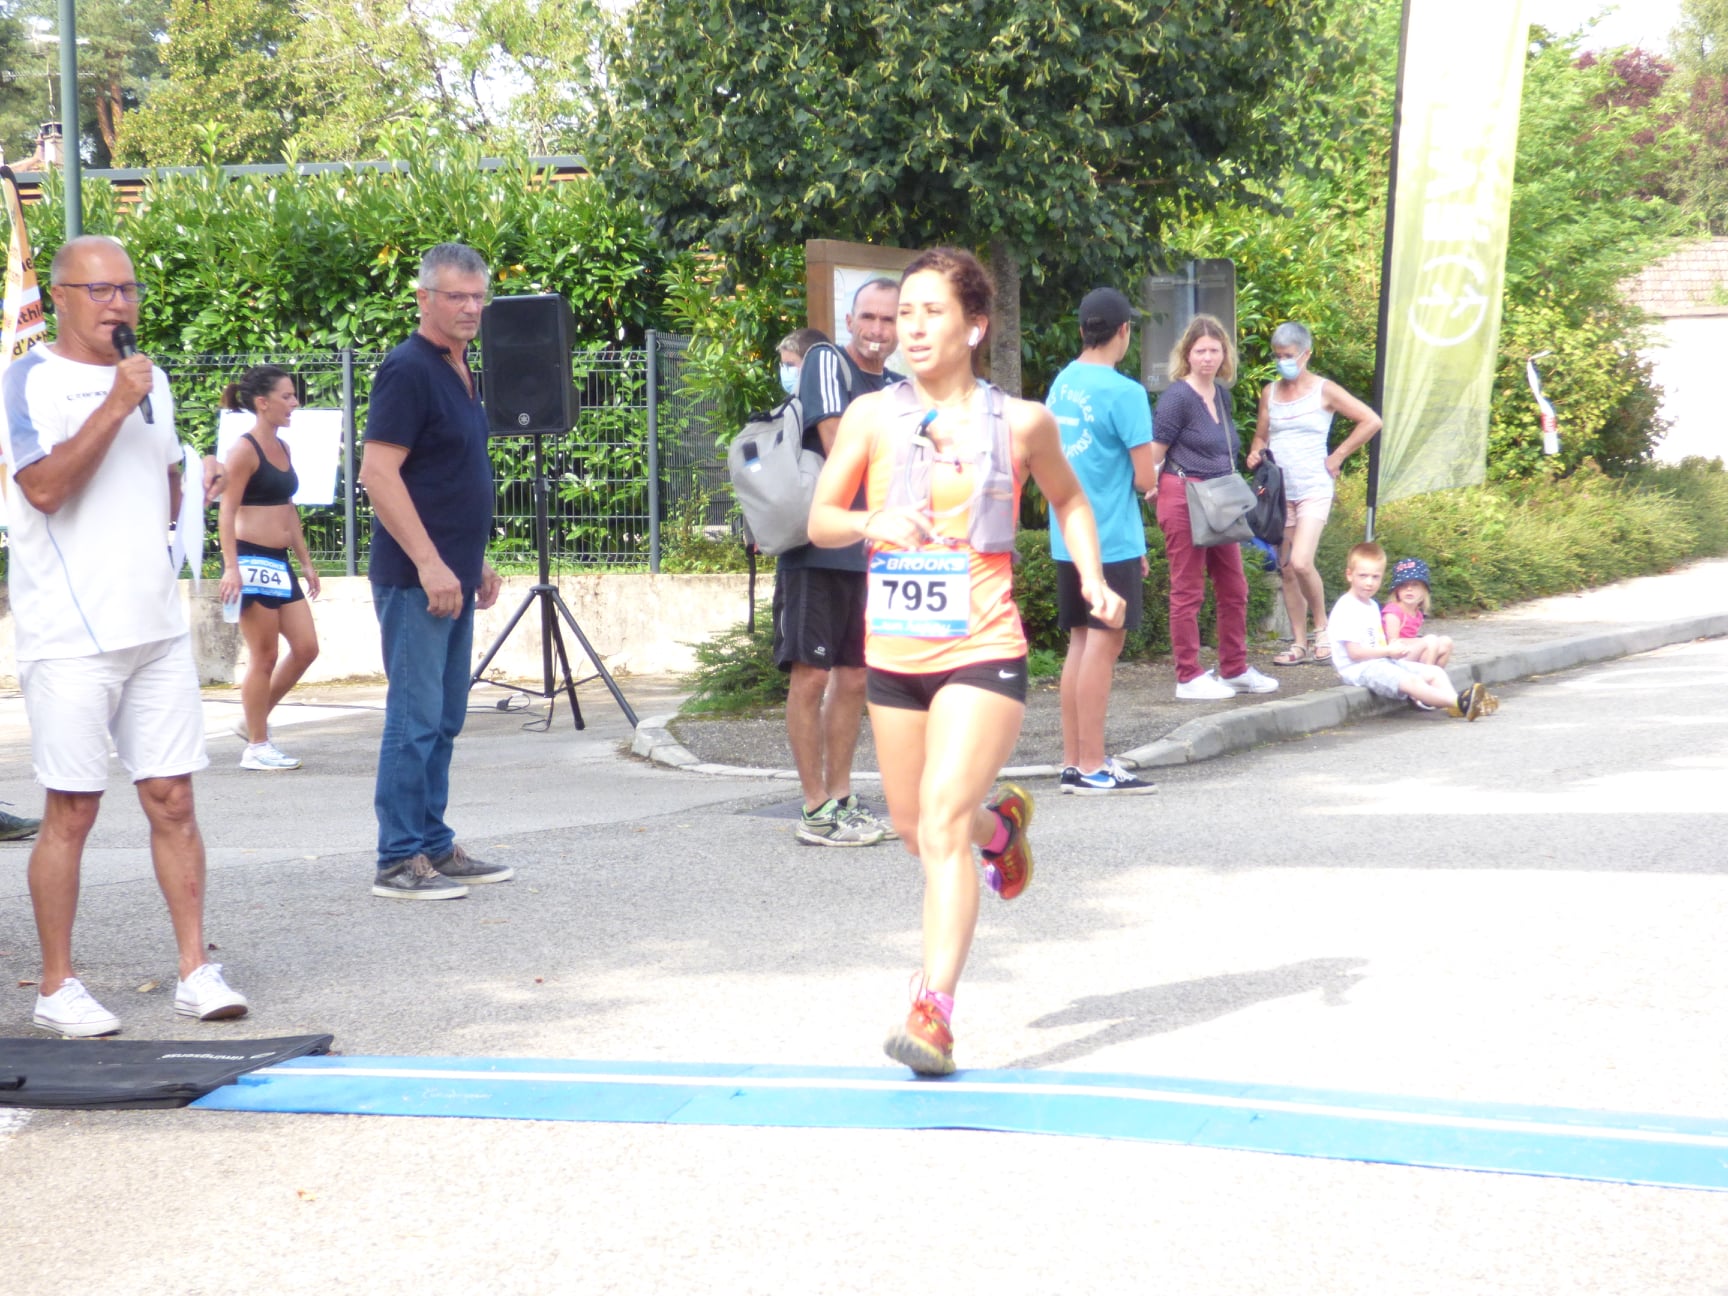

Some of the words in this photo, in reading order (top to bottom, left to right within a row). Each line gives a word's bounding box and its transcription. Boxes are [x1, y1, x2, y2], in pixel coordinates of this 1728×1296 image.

[887, 557, 966, 571] BROOKS
[247, 567, 282, 585] 764
[882, 580, 948, 612] 795
